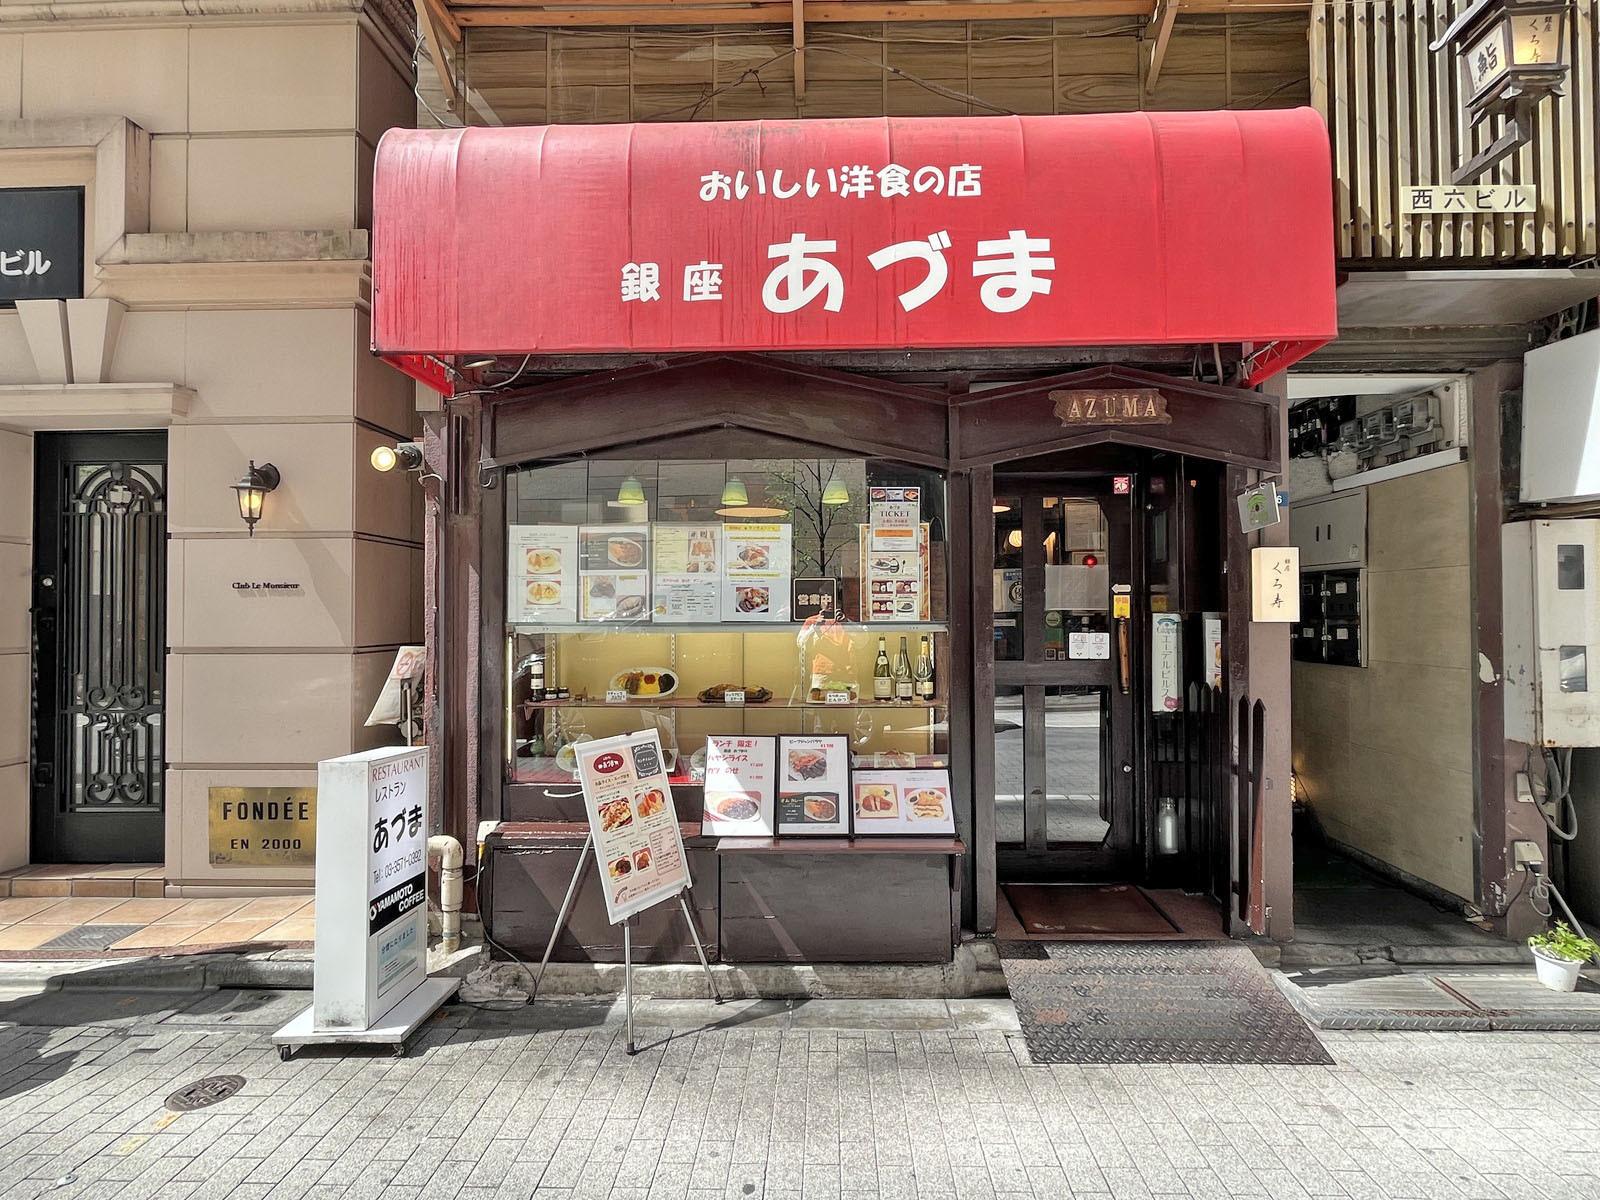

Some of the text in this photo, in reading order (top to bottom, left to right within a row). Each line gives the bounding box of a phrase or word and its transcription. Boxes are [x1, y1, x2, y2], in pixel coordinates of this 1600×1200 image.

[1477, 42, 1498, 82] 鮨
[699, 163, 983, 201] おいしい洋食の店
[1411, 188, 1527, 210] 西六ビル
[0, 249, 52, 276] ビル
[620, 229, 1056, 314] 銀座 あづま
[1068, 396, 1157, 418] AZUMA
[231, 581, 251, 590] Club
[797, 593, 832, 606] 営業中
[712, 739, 733, 748] ランチ
[372, 755, 425, 782] RESTAURANT
[707, 754, 749, 762] ハヤシライス
[375, 781, 407, 803] レストラン
[222, 796, 309, 820] FONDÉE
[373, 804, 423, 854] あづま
[230, 839, 302, 850] EN 2000
[377, 883, 414, 913] YAMAMOTO
[398, 888, 425, 913] COFFEE
